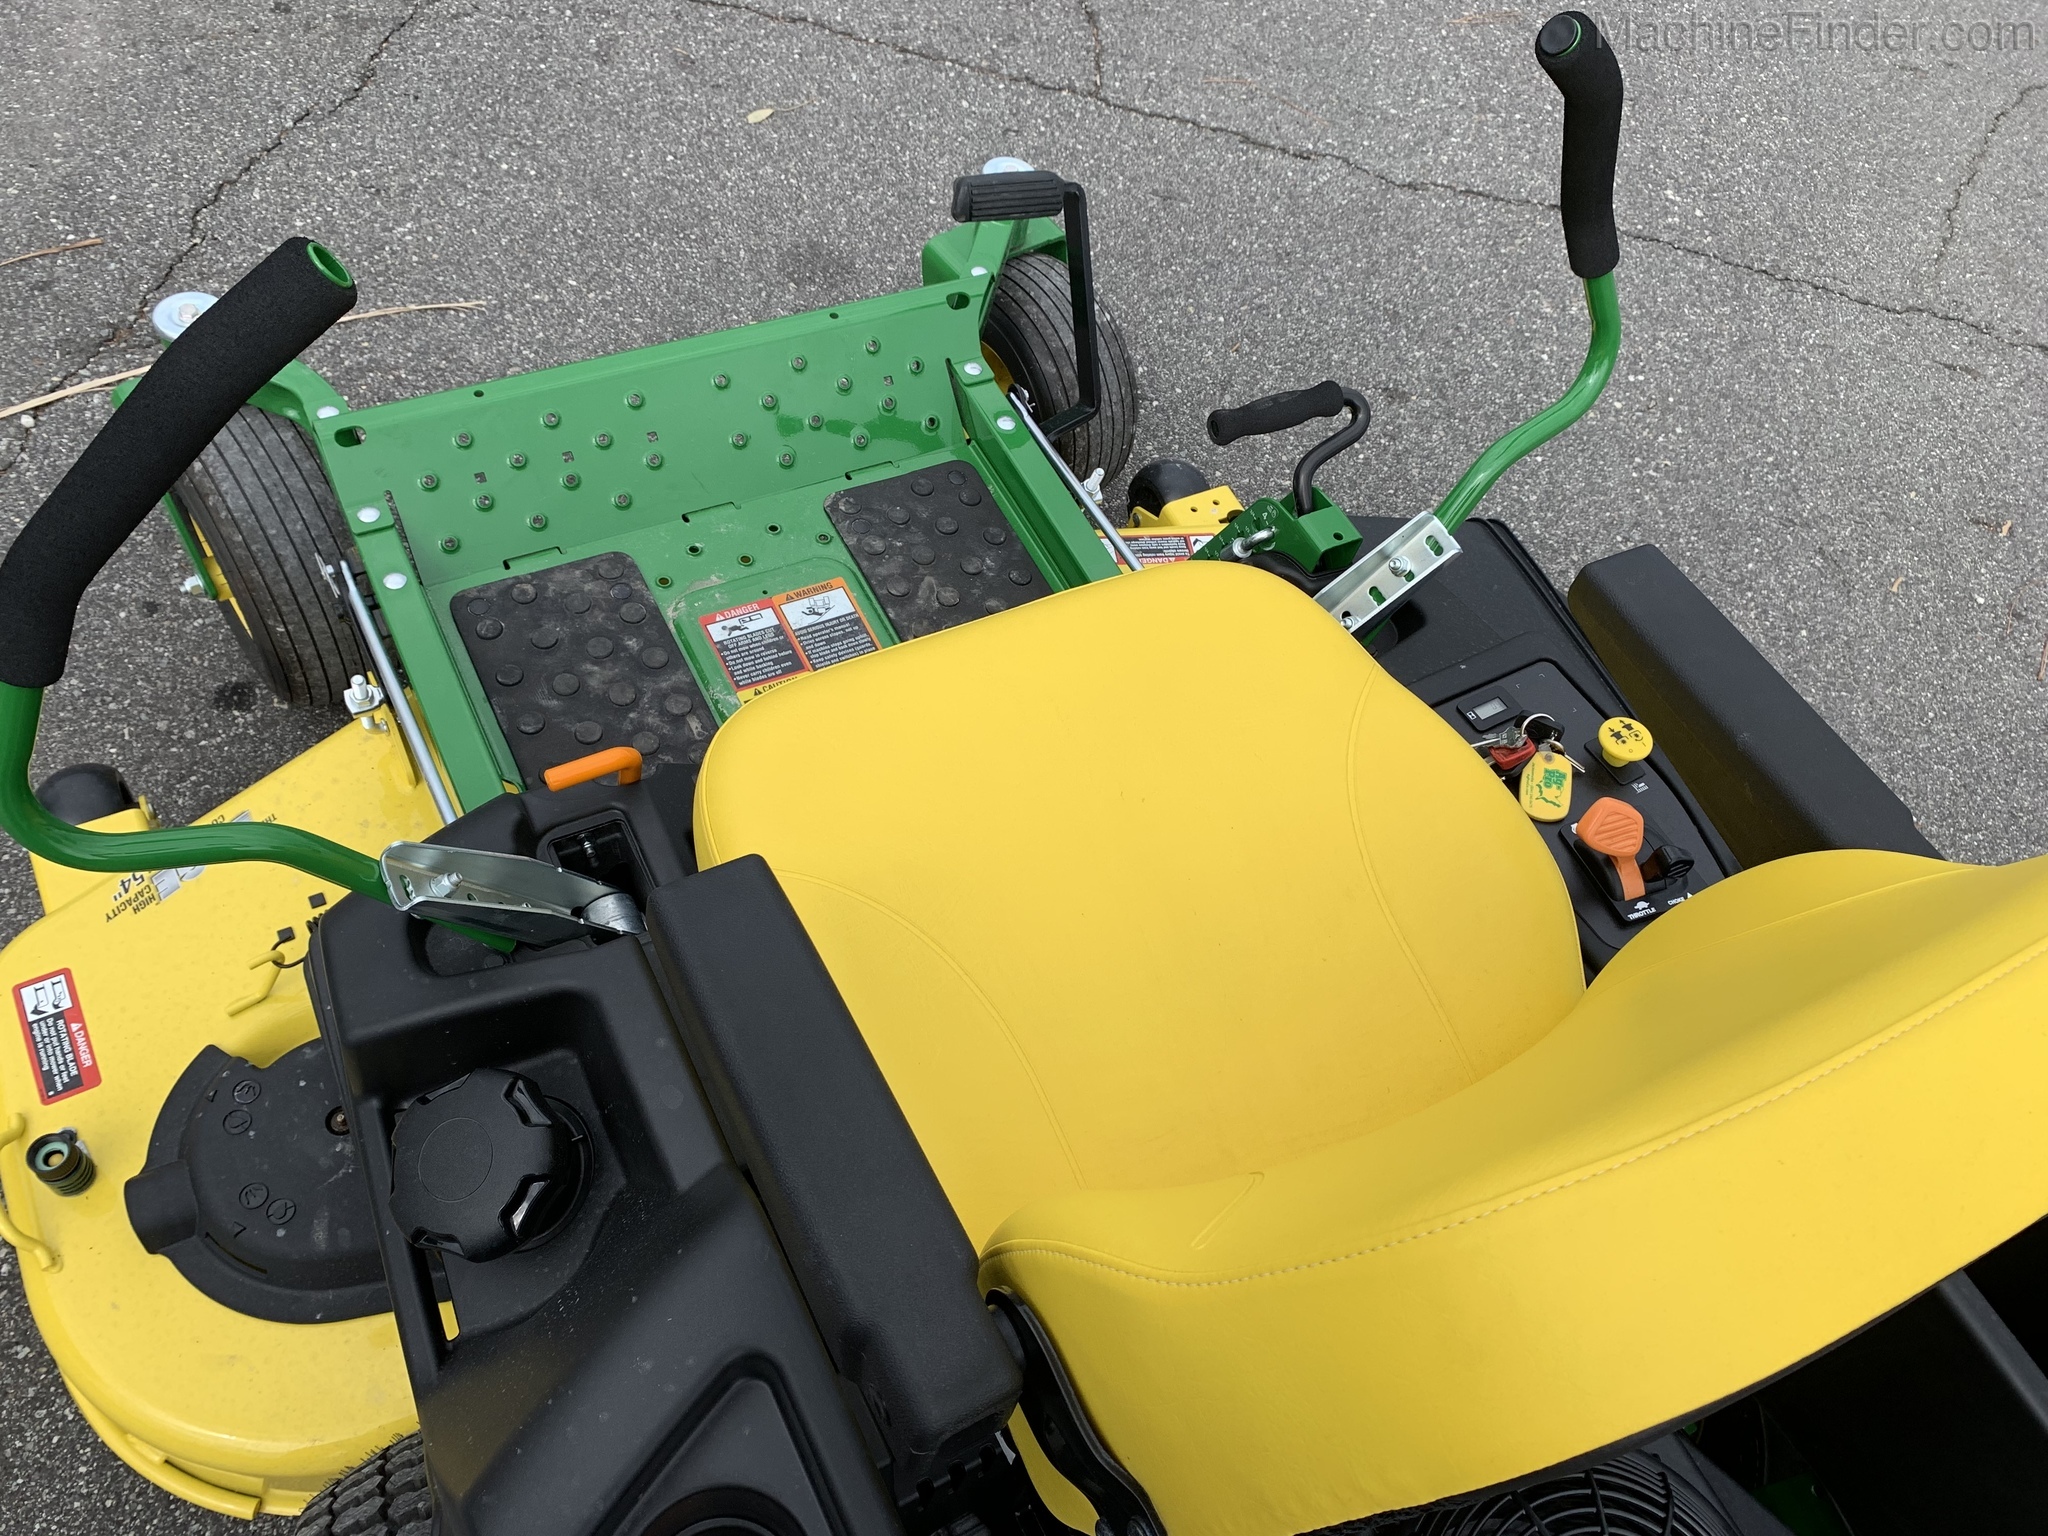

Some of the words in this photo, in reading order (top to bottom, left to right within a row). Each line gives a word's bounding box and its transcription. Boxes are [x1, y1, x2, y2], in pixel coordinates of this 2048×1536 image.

[793, 582, 833, 598] WARNING
[723, 603, 760, 618] DANGER
[755, 661, 773, 669] backing
[112, 872, 145, 902] 54"
[105, 884, 152, 922] CAPACITY
[134, 891, 156, 914] HIGH
[1667, 896, 1685, 905] CHOKE
[1627, 907, 1656, 919] THROTTLE
[46, 1017, 54, 1026] Do
[48, 1026, 56, 1036] not
[30, 1022, 41, 1042] engine
[37, 1048, 49, 1071] running
[50, 1036, 59, 1046] put
[56, 1018, 71, 1053] ROTATING
[65, 1052, 78, 1076] BLADE
[74, 1030, 92, 1067] DANGER
[39, 1020, 48, 1036] under
[48, 1055, 58, 1075] mower
[53, 1074, 63, 1091] when
[53, 1046, 64, 1064] hands
[60, 1070, 69, 1083] feet
